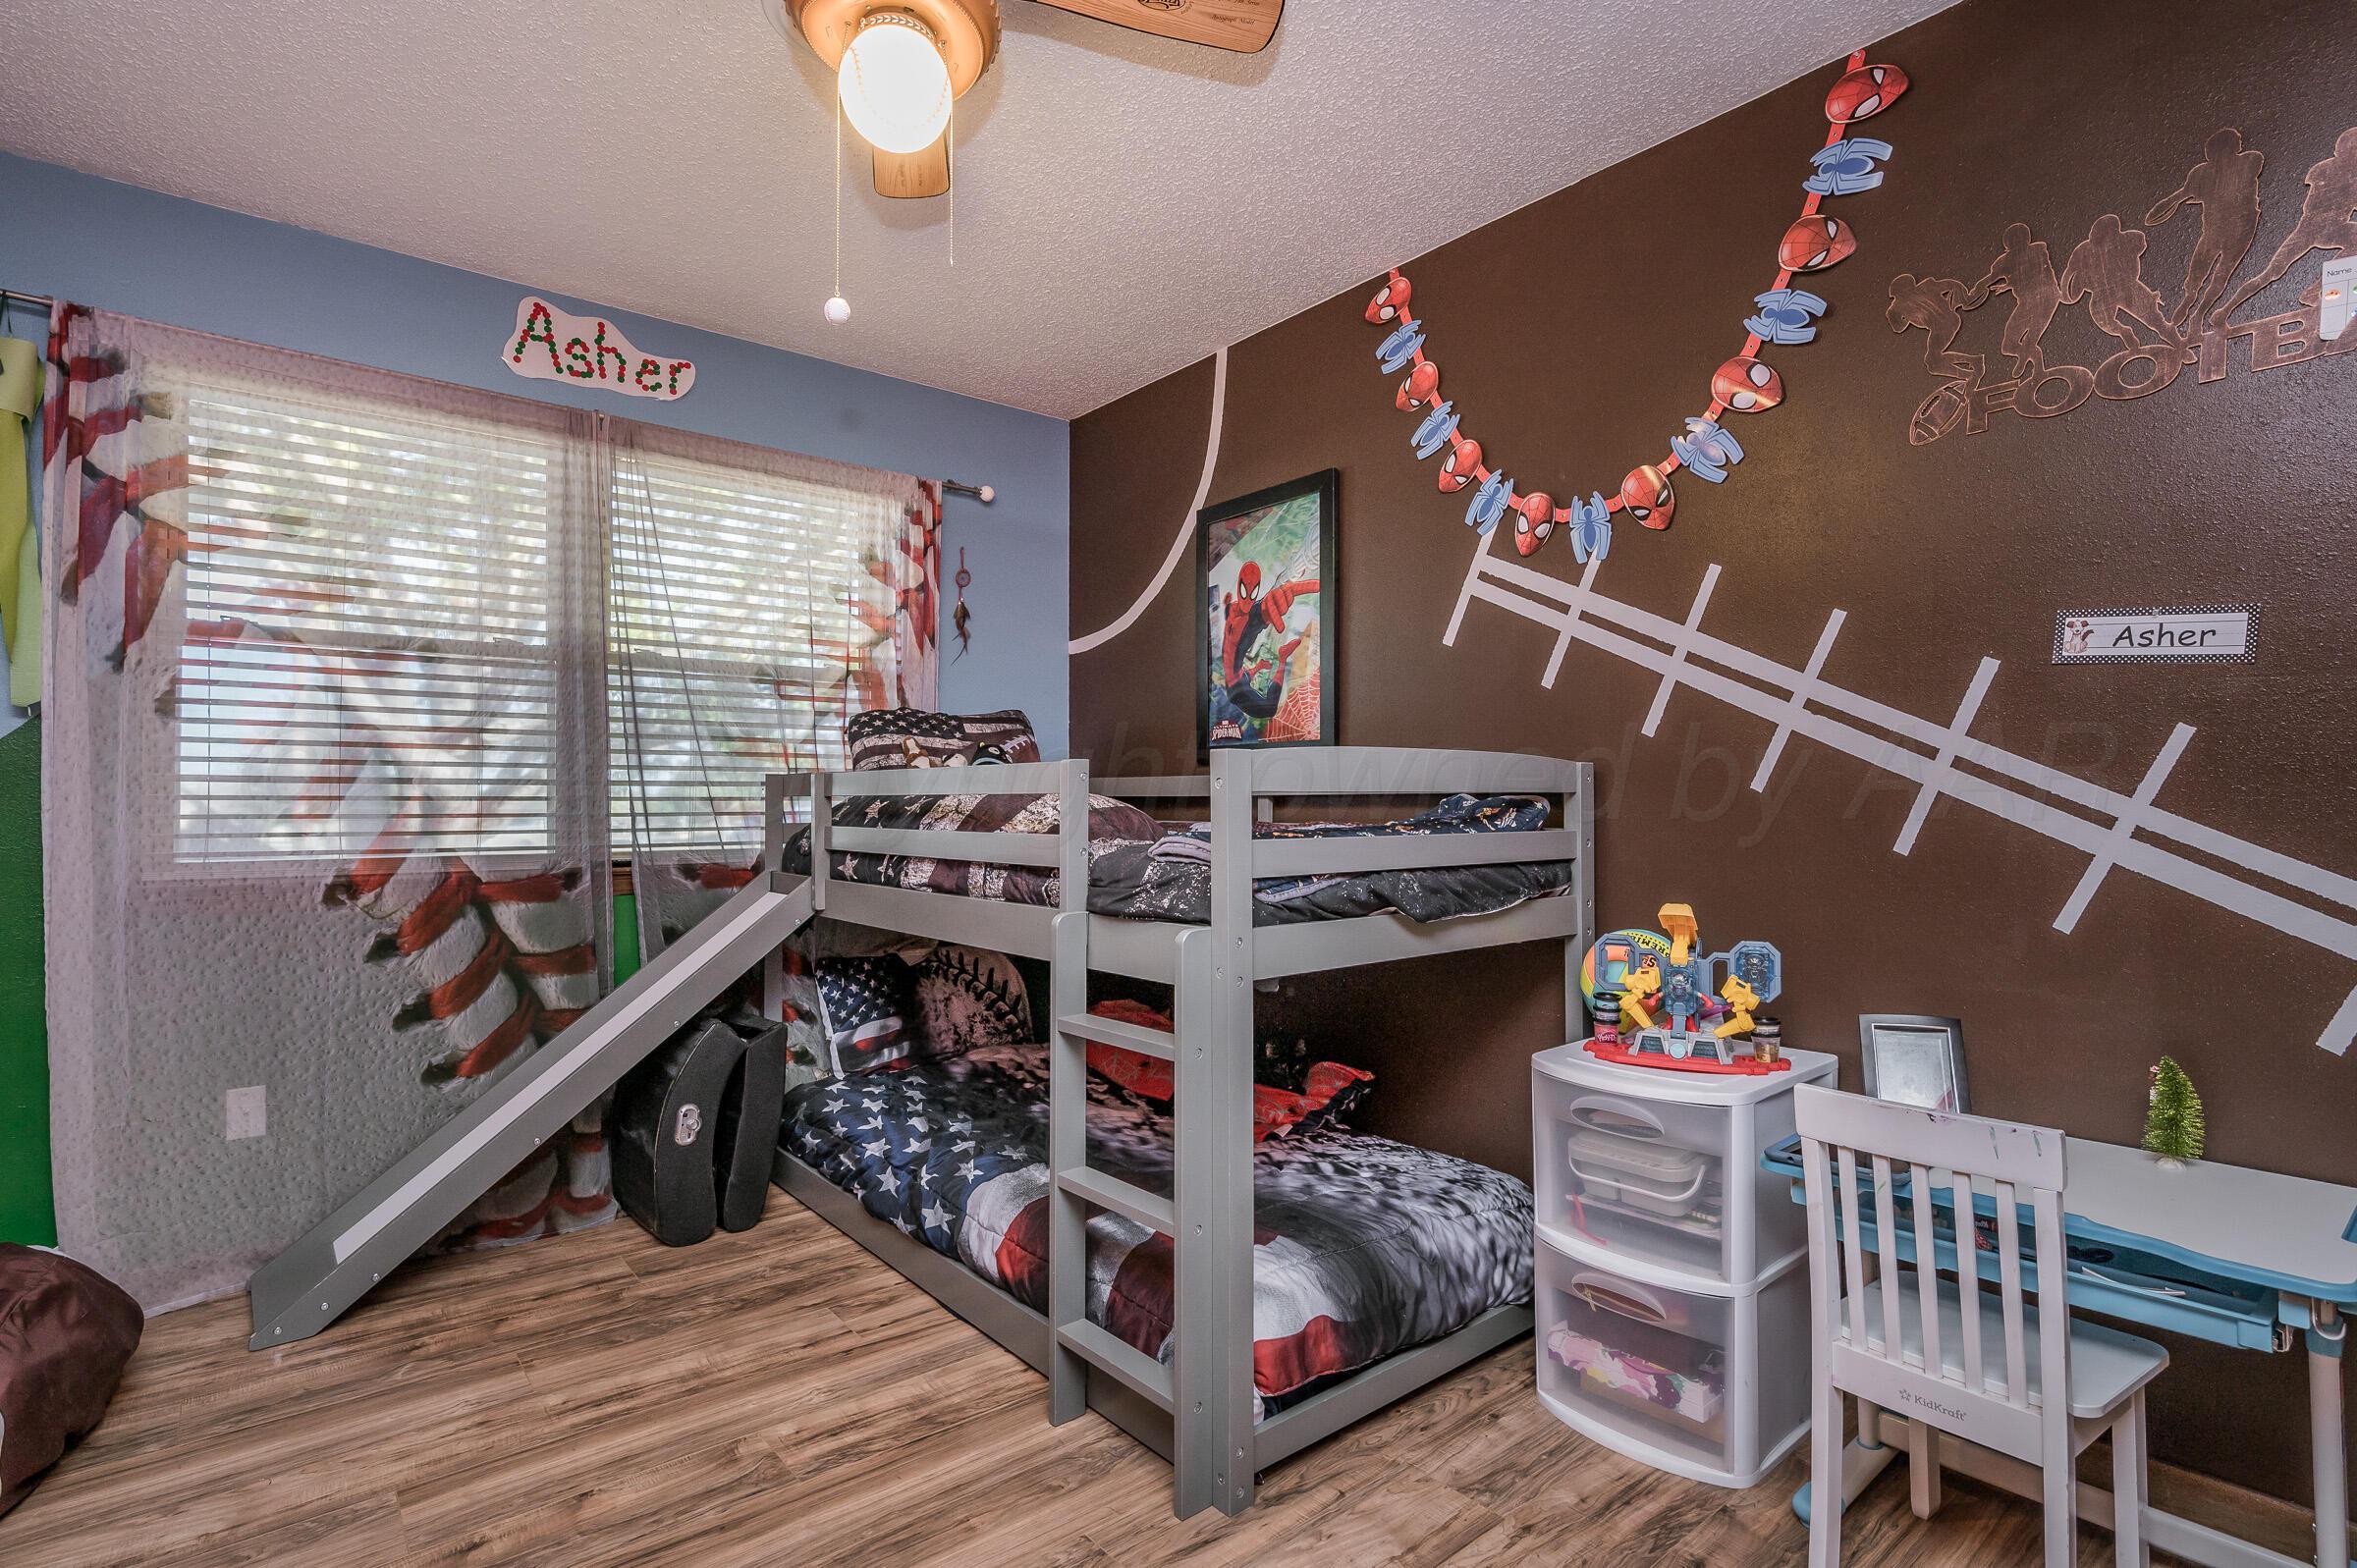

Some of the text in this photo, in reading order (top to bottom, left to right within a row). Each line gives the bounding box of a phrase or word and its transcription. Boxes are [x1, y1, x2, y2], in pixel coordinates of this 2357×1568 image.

[2327, 267, 2352, 278] Name
[513, 301, 692, 397] Asher
[2111, 622, 2217, 647] Asher
[1211, 728, 1242, 741] SPIDER-MAN
[1914, 1394, 1966, 1422] KidKraft
